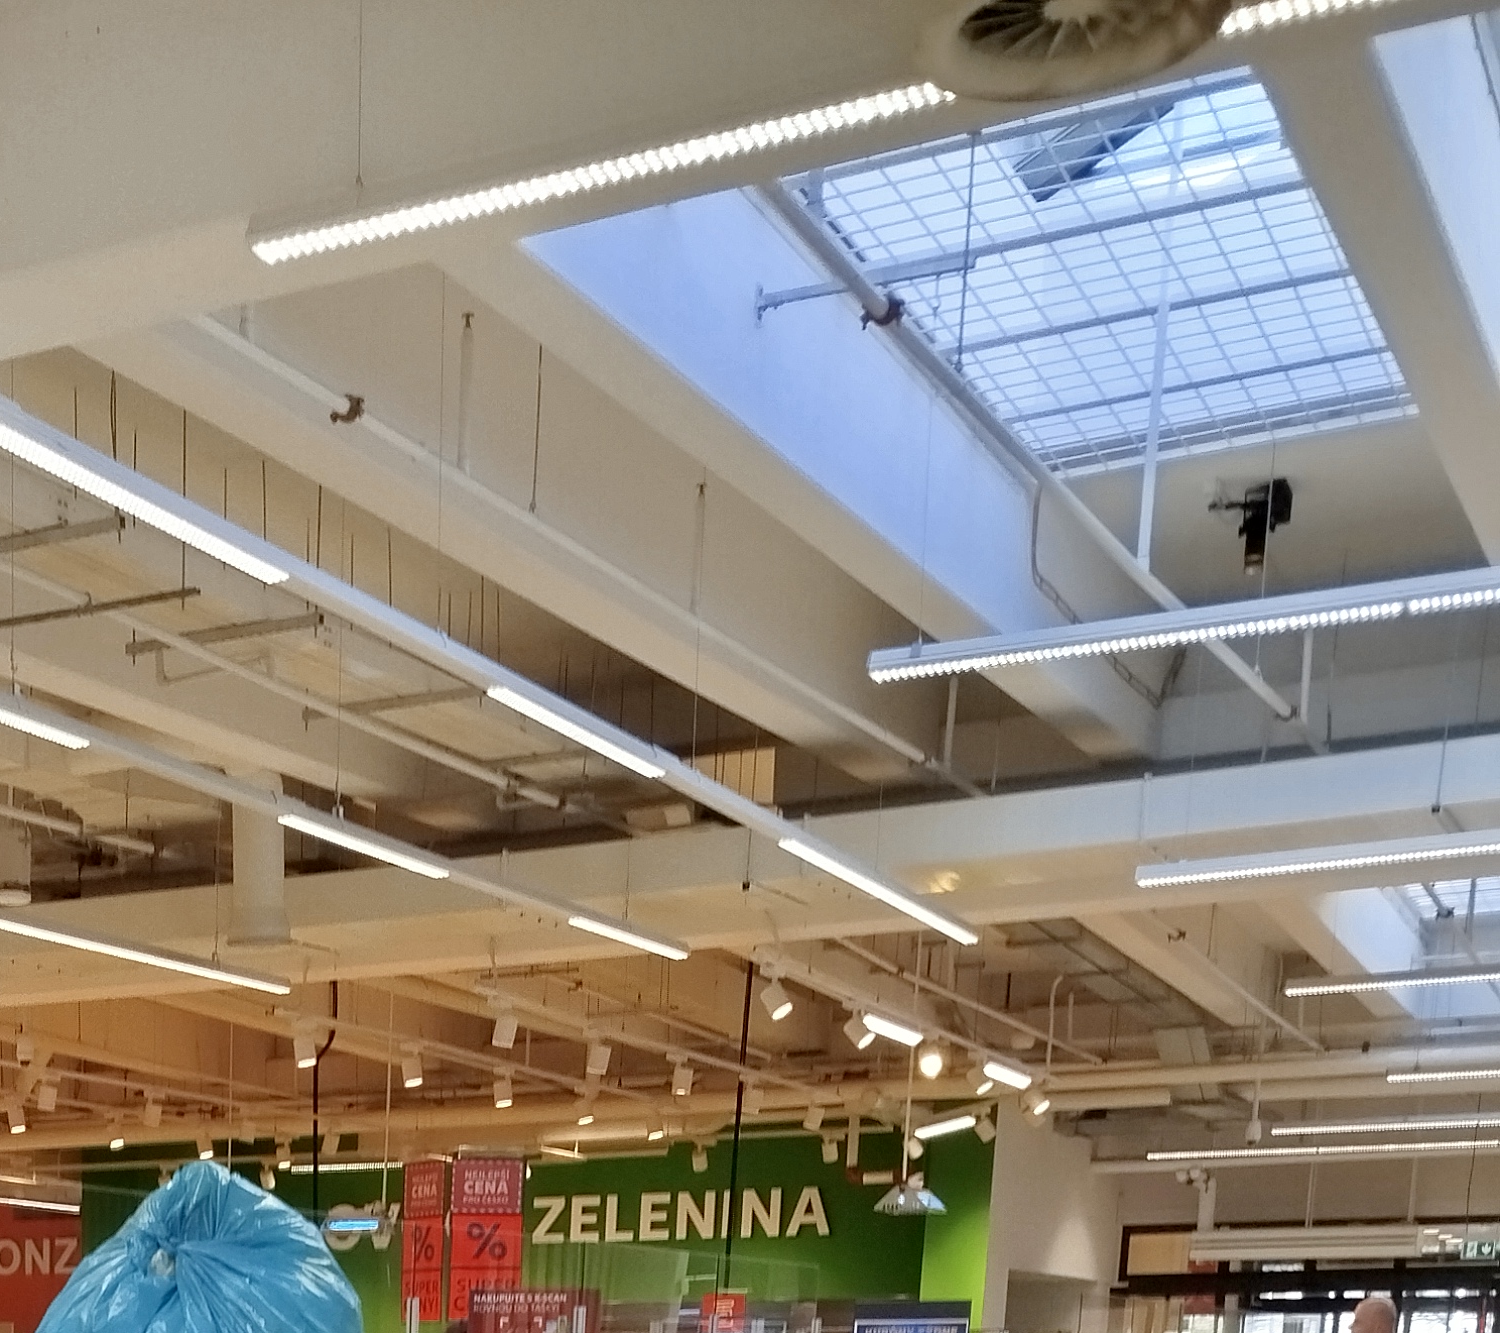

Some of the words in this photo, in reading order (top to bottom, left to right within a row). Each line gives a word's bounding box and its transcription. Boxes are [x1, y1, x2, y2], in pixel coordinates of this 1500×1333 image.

[464, 1180, 509, 1195] CENA
[532, 1185, 831, 1245] ZELENINA
[467, 1222, 508, 1261] %
[473, 1292, 526, 1304] NAKUPUJTE
